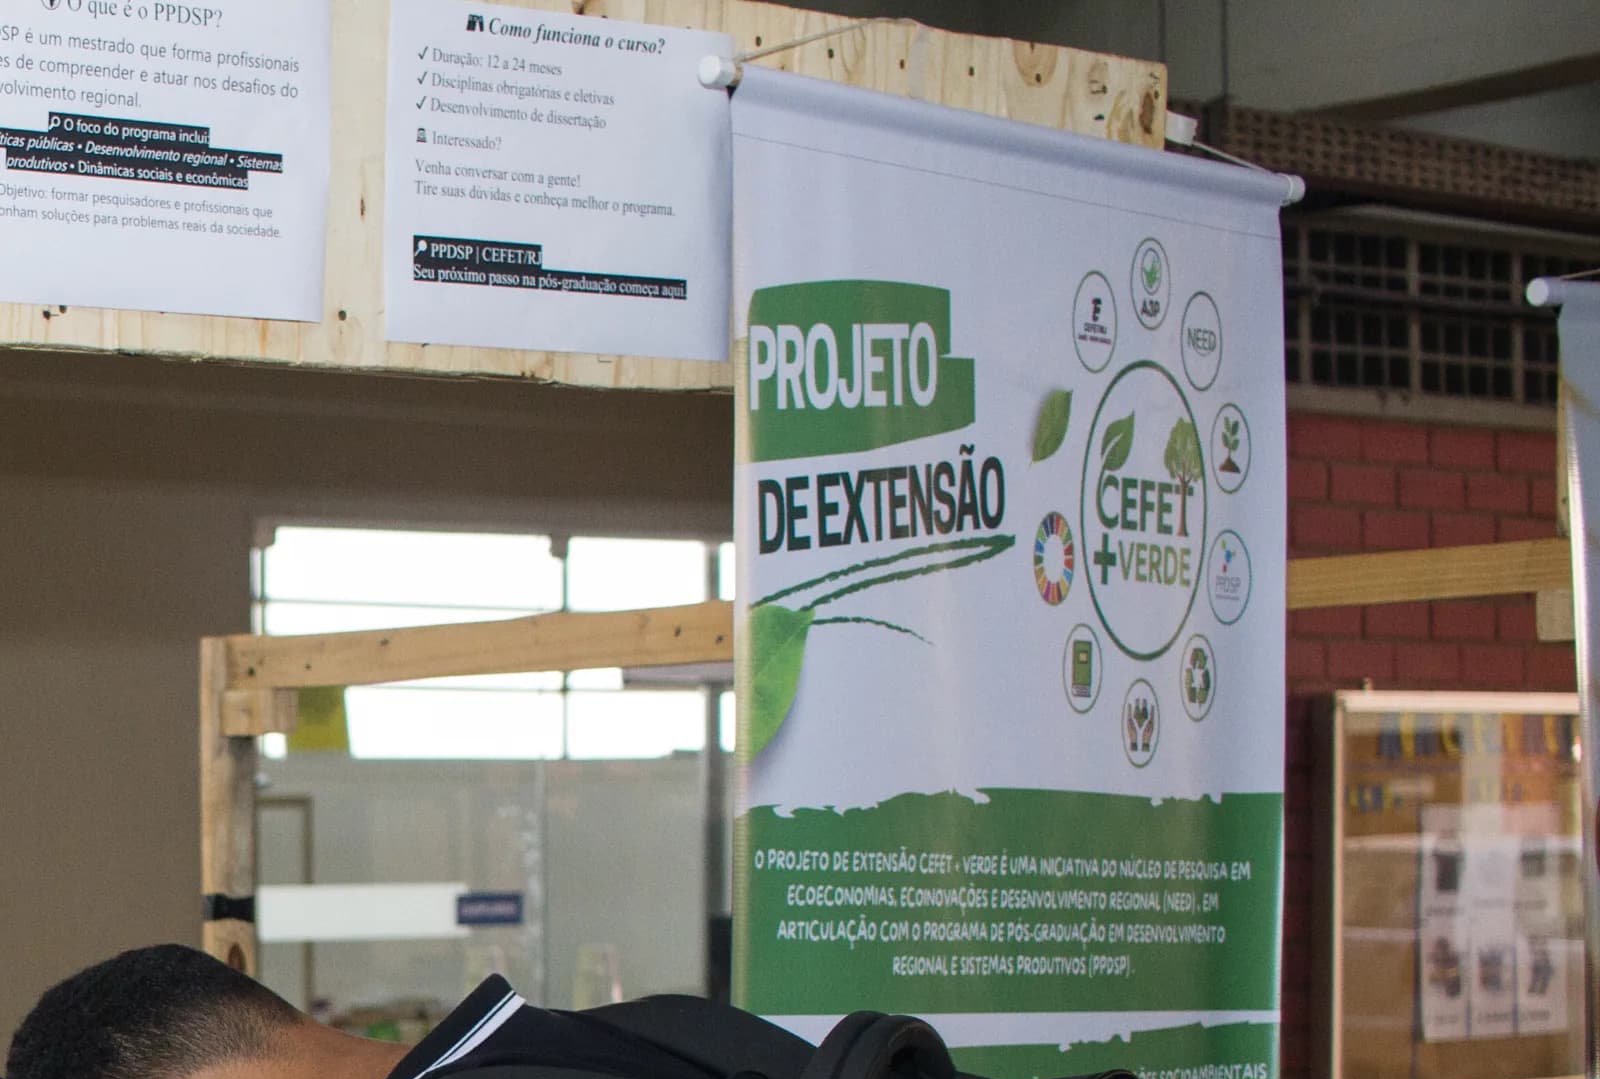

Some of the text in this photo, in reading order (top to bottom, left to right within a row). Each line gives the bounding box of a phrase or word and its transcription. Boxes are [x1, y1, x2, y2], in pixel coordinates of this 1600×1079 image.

[66, 0, 223, 28] O que o PPDSP?
[24, 30, 34, 44] é
[38, 32, 62, 46] um
[67, 35, 135, 55] mestrado
[139, 43, 167, 60] que
[171, 42, 212, 63] forma
[216, 50, 300, 73] profissionais
[488, 17, 666, 55] Como funciona o curso?
[14, 54, 34, 71] de
[38, 59, 135, 81] compreender
[139, 69, 149, 83] e
[152, 69, 189, 86] atuar
[192, 75, 217, 90] nos
[221, 75, 276, 96] desafios
[279, 81, 298, 99] do
[487, 53, 500, 69] 12
[501, 59, 509, 70] a
[511, 56, 526, 72] 24
[528, 62, 563, 76] meses
[80, 87, 141, 109] regional.
[431, 71, 615, 105] Disciplinas obrigatórias e eletivas
[62, 117, 210, 144] O foco do programa inclui:
[429, 96, 607, 131] Desenvolvimento de dissertação
[6, 153, 249, 188] produtivos Dinâmicas sociais e econômicas
[24, 135, 75, 157] públicas
[84, 140, 181, 164] Desenvolvimento
[181, 149, 227, 171] regional
[236, 154, 283, 173] Sistemas
[414, 158, 452, 176] Venha
[453, 165, 509, 181] conversar
[510, 171, 535, 184] com
[536, 173, 545, 185] a
[50, 186, 89, 202] formar
[91, 192, 172, 210] pesquisadores
[173, 199, 181, 210] e
[182, 199, 250, 217] profissionais
[251, 207, 273, 220] que
[414, 179, 438, 196] Tire
[440, 185, 466, 198] suas
[467, 184, 512, 202] dúvidas
[513, 192, 521, 204] e
[522, 190, 569, 210] conheça
[570, 194, 610, 211] melhor
[611, 200, 620, 212] o
[40, 207, 90, 225] soluções
[92, 213, 119, 227] para
[120, 214, 180, 230] problemas
[181, 219, 207, 233] reais
[209, 220, 224, 234] da
[225, 223, 281, 238] sociedade.
[430, 242, 542, 266] PPDSP CEFET/RJ
[413, 265, 437, 280] Seu
[436, 267, 487, 286] próximo
[487, 273, 520, 289] passo
[520, 276, 537, 288] na
[537, 274, 617, 296] pós-graduação
[618, 283, 660, 299] começa
[1187, 328, 1216, 352] NEED
[749, 322, 938, 411] PROJETO
[758, 444, 1006, 554] DE EXTENSÃO
[1097, 474, 1195, 537] CEFET
[753, 847, 1251, 881] O PROJETO DE EXTENSÃO CEFET VERDE É UMA INICIATIVA DO NÚCLEO DE PESQUISA EM
[899, 885, 989, 914] ECOINOVAÇÕES
[990, 887, 998, 909] E
[999, 887, 1107, 910] DESENVOLVIMENTO
[1108, 890, 1161, 911] REGIONAL
[1202, 891, 1219, 912] EM
[776, 918, 1226, 950] ARTICULAÇÃO COM O PROGRAMA DE PÓS-GRADUAÇÃO EM DESENVOLVIMENTO
[892, 953, 1087, 976] REGIONAL E SISTEMAS PRODUTIVOS
